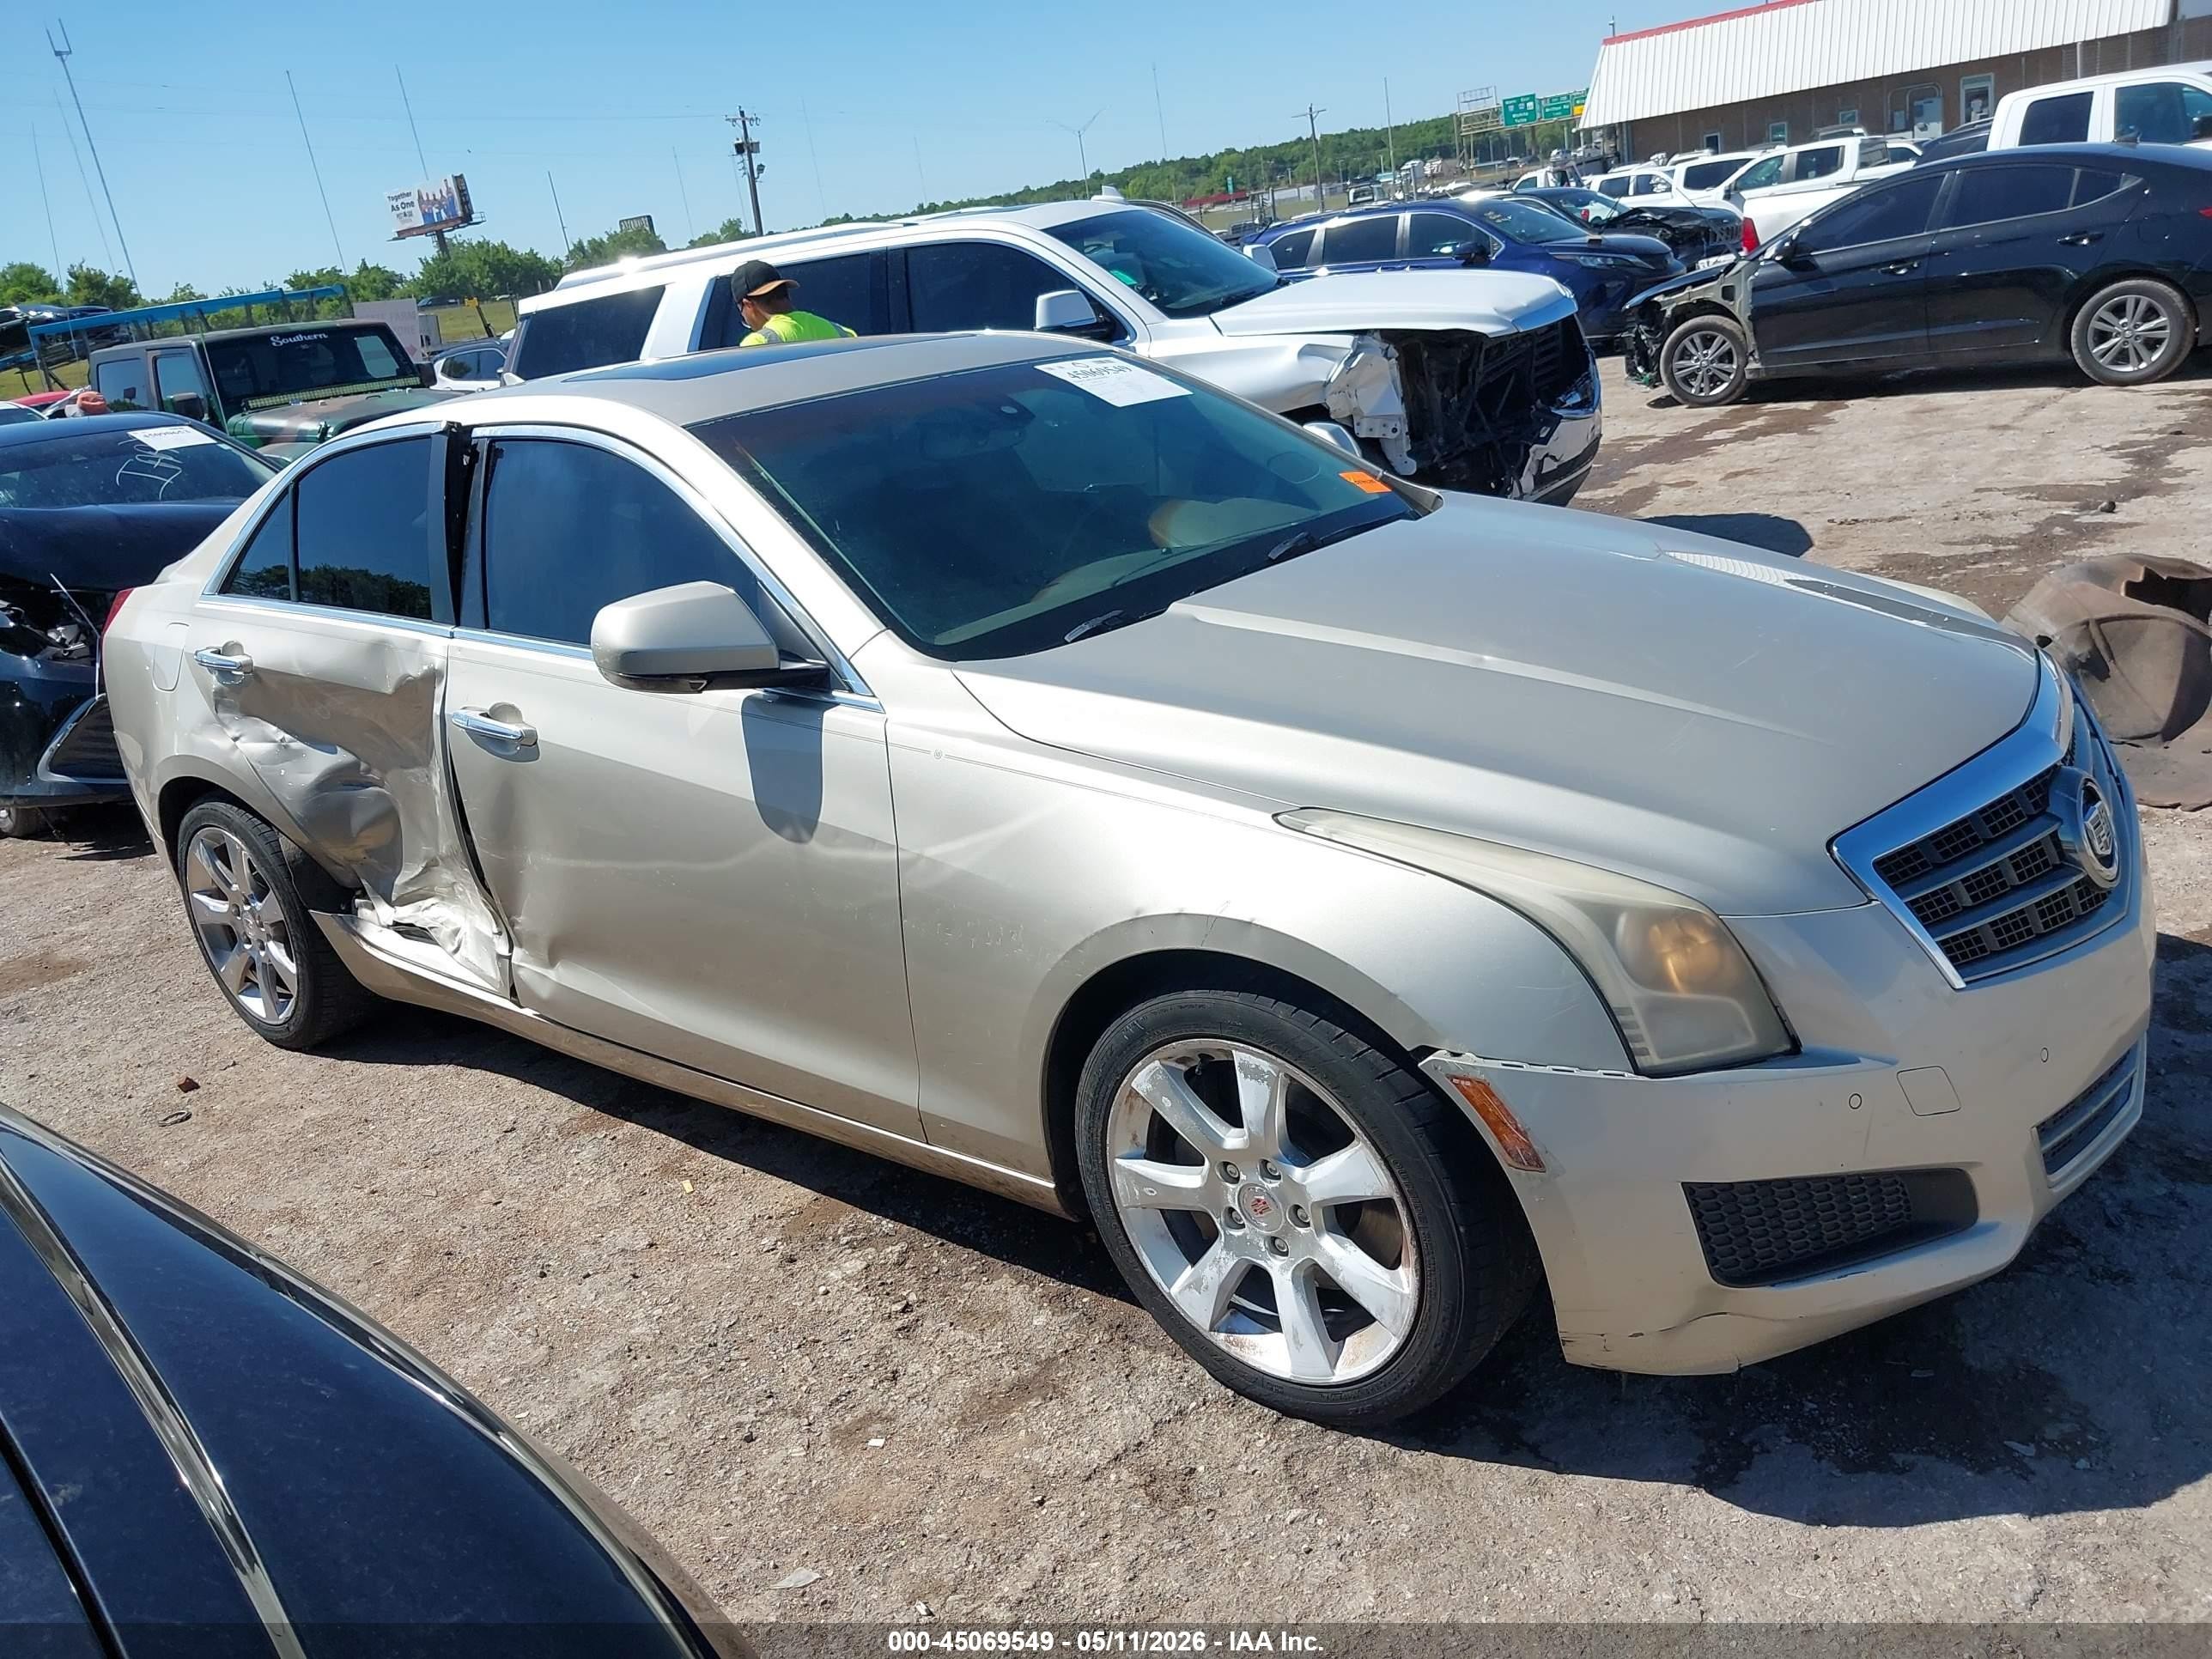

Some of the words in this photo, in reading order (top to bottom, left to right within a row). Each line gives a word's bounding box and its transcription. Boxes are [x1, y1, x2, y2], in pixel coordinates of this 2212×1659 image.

[387, 191, 412, 202] Together
[391, 204, 400, 212] As
[400, 200, 415, 210] One
[270, 332, 329, 347] Southern
[1066, 365, 1133, 380] 45069549
